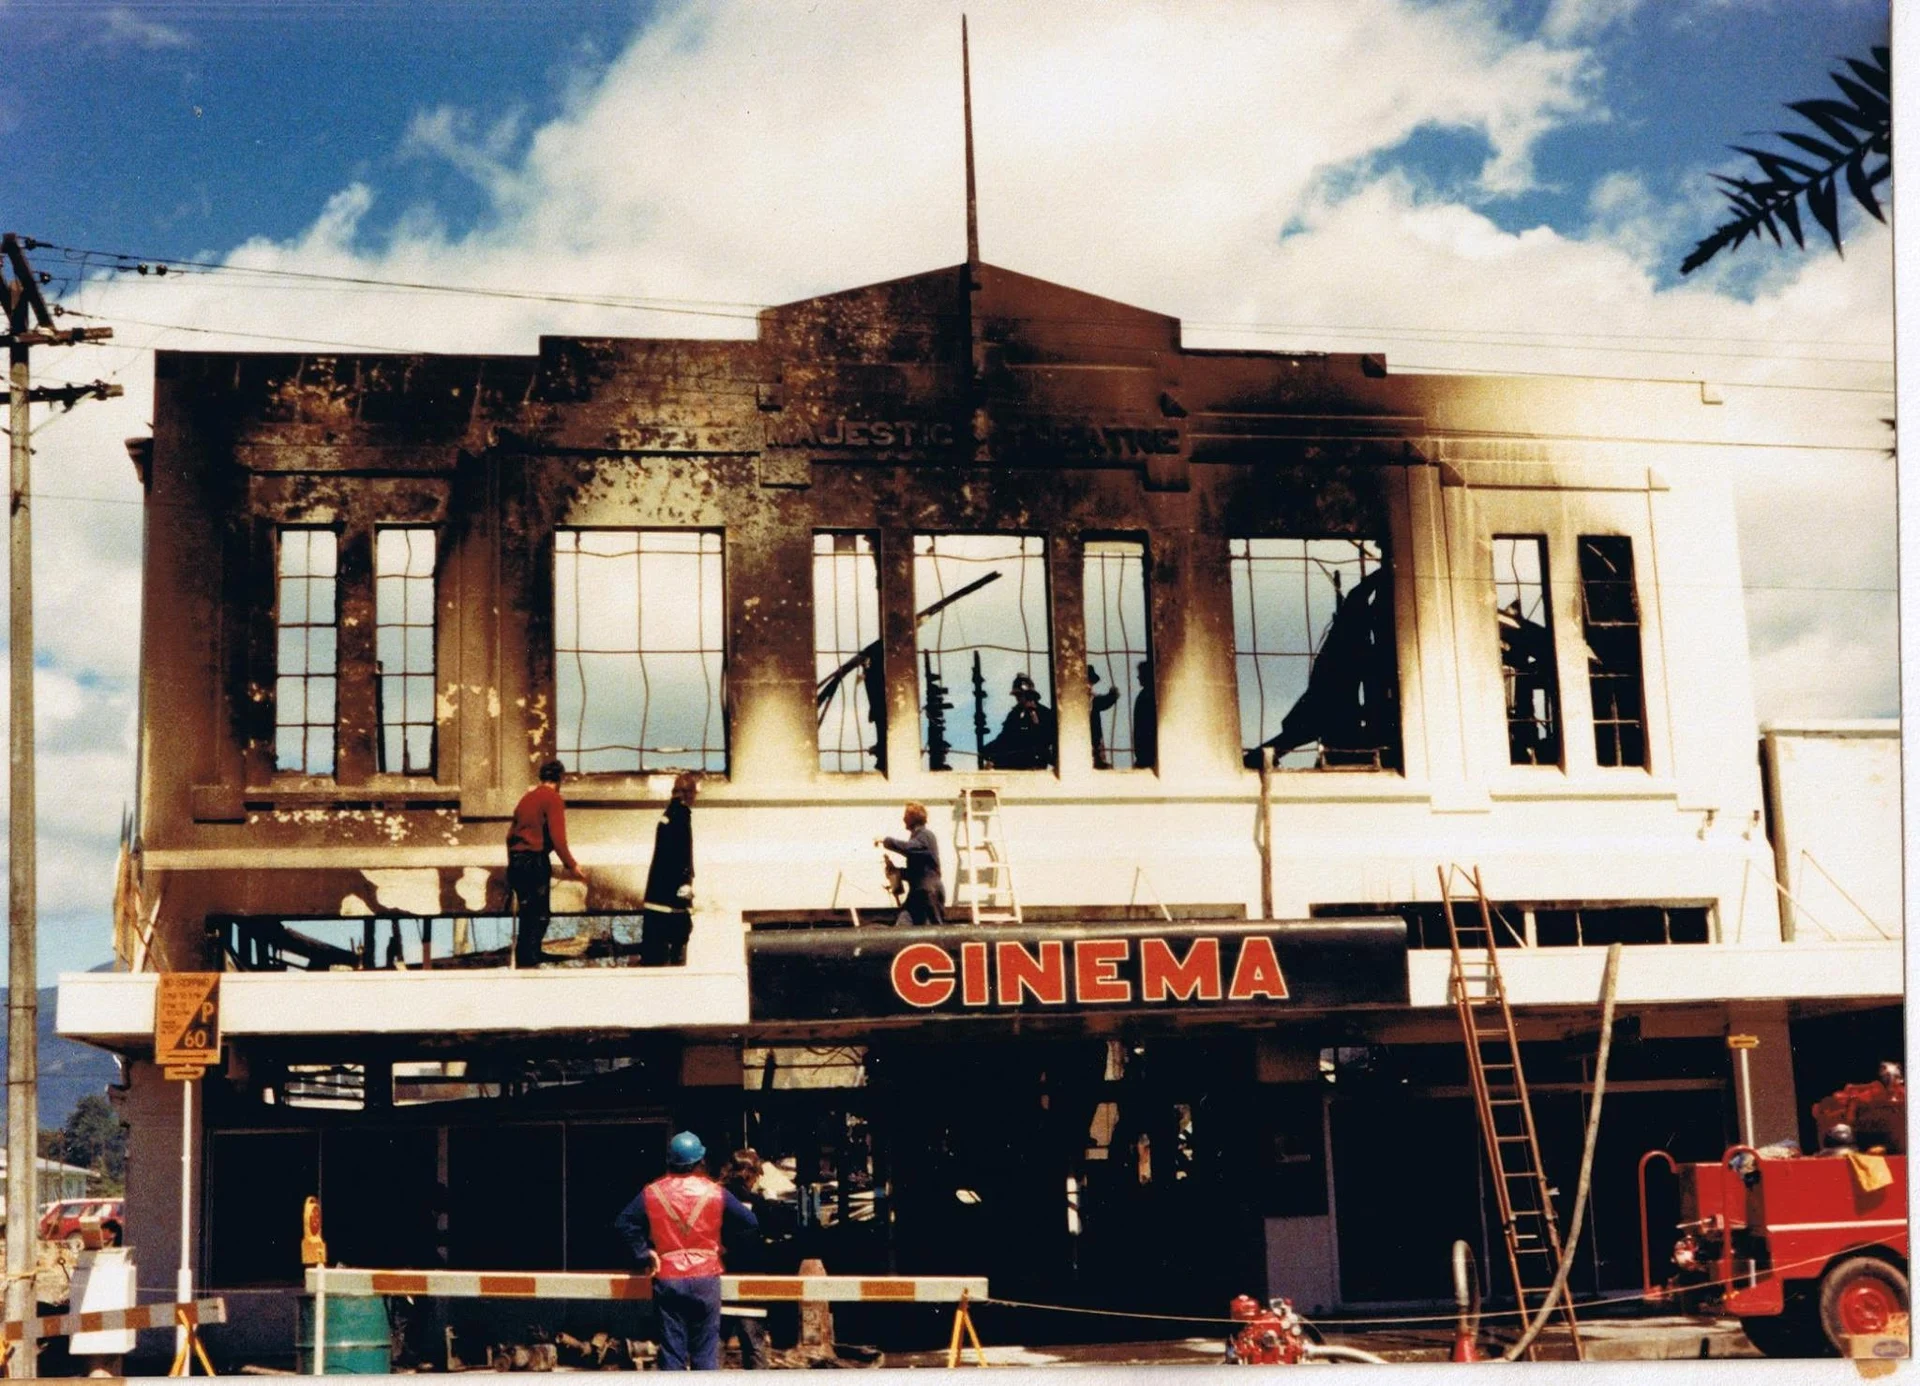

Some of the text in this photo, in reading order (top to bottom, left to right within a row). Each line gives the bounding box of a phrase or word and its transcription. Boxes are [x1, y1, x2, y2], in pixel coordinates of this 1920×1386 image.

[765, 420, 953, 447] MAJESTIC
[891, 936, 1290, 1008] CINEMA
[202, 1001, 214, 1022] P
[184, 1029, 206, 1048] 60
